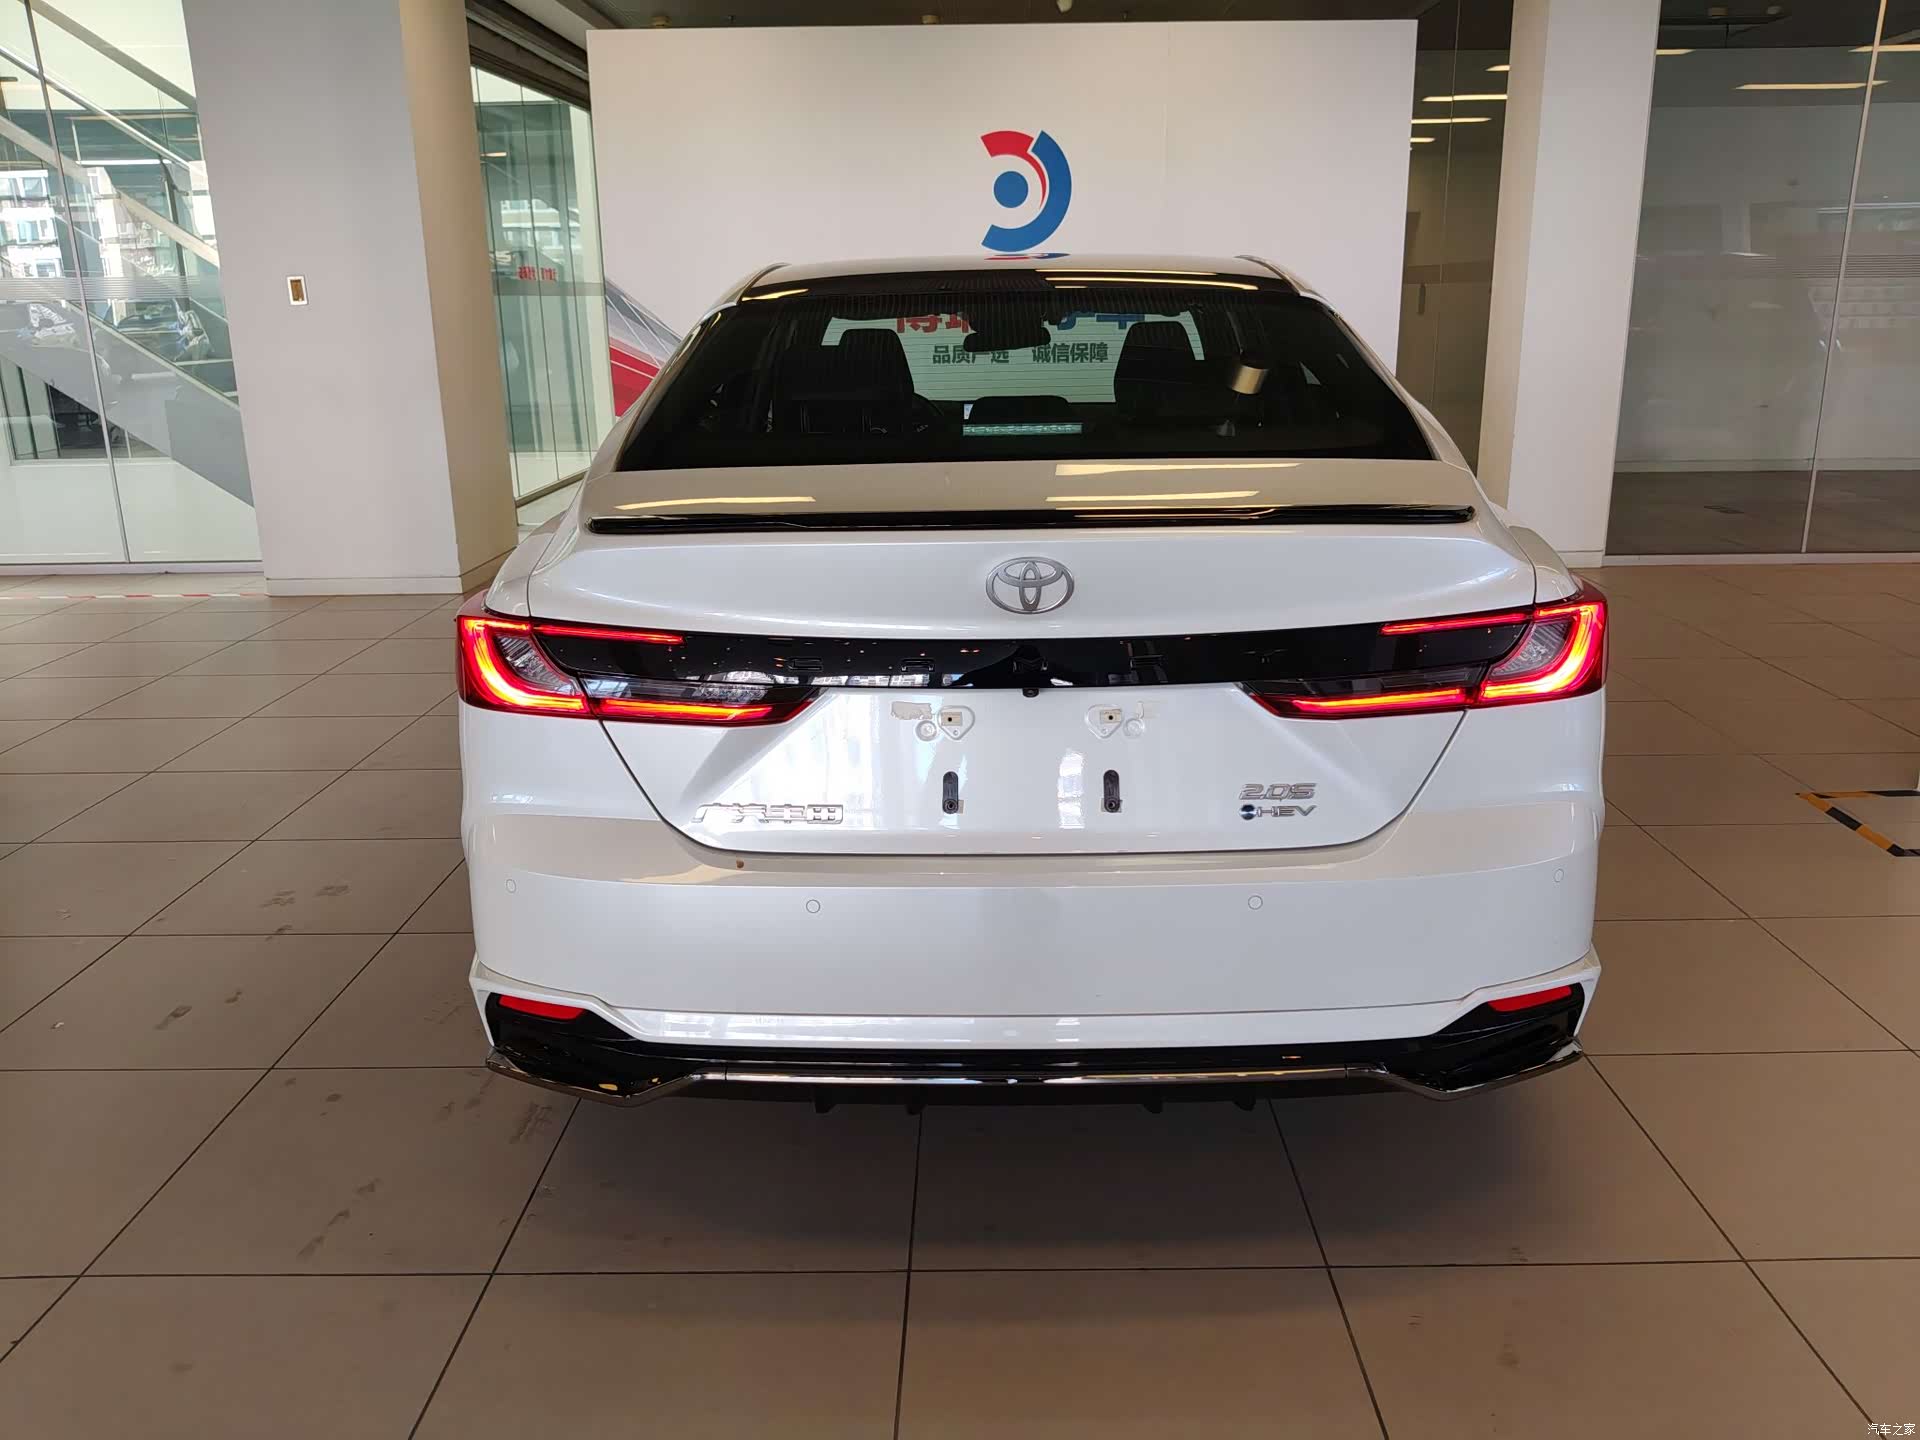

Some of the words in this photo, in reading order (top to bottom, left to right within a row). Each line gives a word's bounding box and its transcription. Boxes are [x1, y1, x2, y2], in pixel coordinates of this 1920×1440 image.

[1032, 342, 1109, 363] 诚信保障
[1257, 804, 1317, 817] HEV
